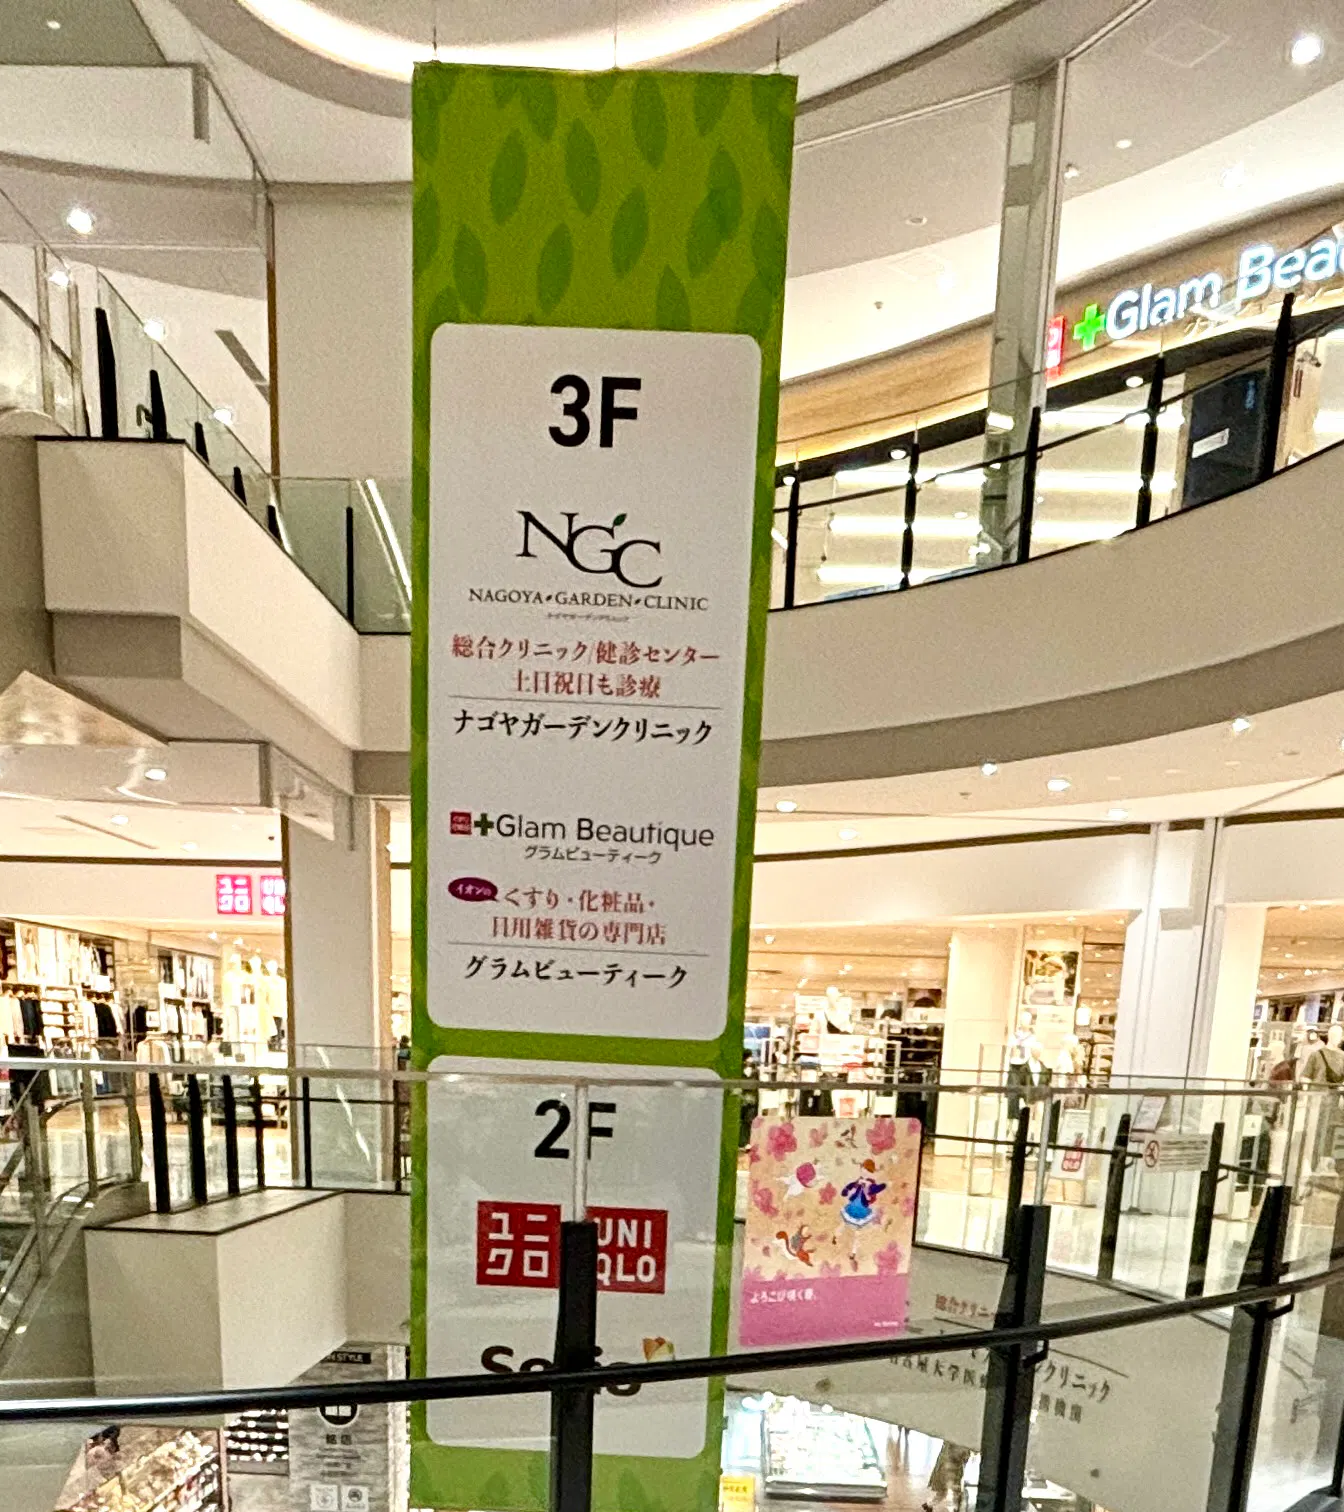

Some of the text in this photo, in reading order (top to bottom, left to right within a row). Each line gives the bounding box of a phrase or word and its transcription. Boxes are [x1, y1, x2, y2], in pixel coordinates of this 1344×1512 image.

[1105, 271, 1223, 340] Glam
[549, 374, 642, 448] 3F
[516, 510, 663, 588] NGC
[468, 588, 709, 612] NAGOYA GARDEN CLINIC
[453, 709, 713, 746] ナゴヤガーデンクリニック
[496, 813, 567, 840] Glam
[577, 817, 716, 852] Beautique
[524, 845, 662, 864] グラムビューティーク
[262, 878, 287, 896] UN
[262, 895, 287, 915] QL
[491, 915, 667, 946] 日用雑貨の専門店
[463, 954, 688, 989] グラムビューティーク
[533, 1099, 617, 1160] 2F
[488, 1211, 550, 1243] ユニ
[592, 1217, 652, 1249] UNI
[485, 1248, 550, 1278] クロ
[596, 1252, 657, 1286] QLO
[935, 1294, 996, 1318] 総合クリニ
